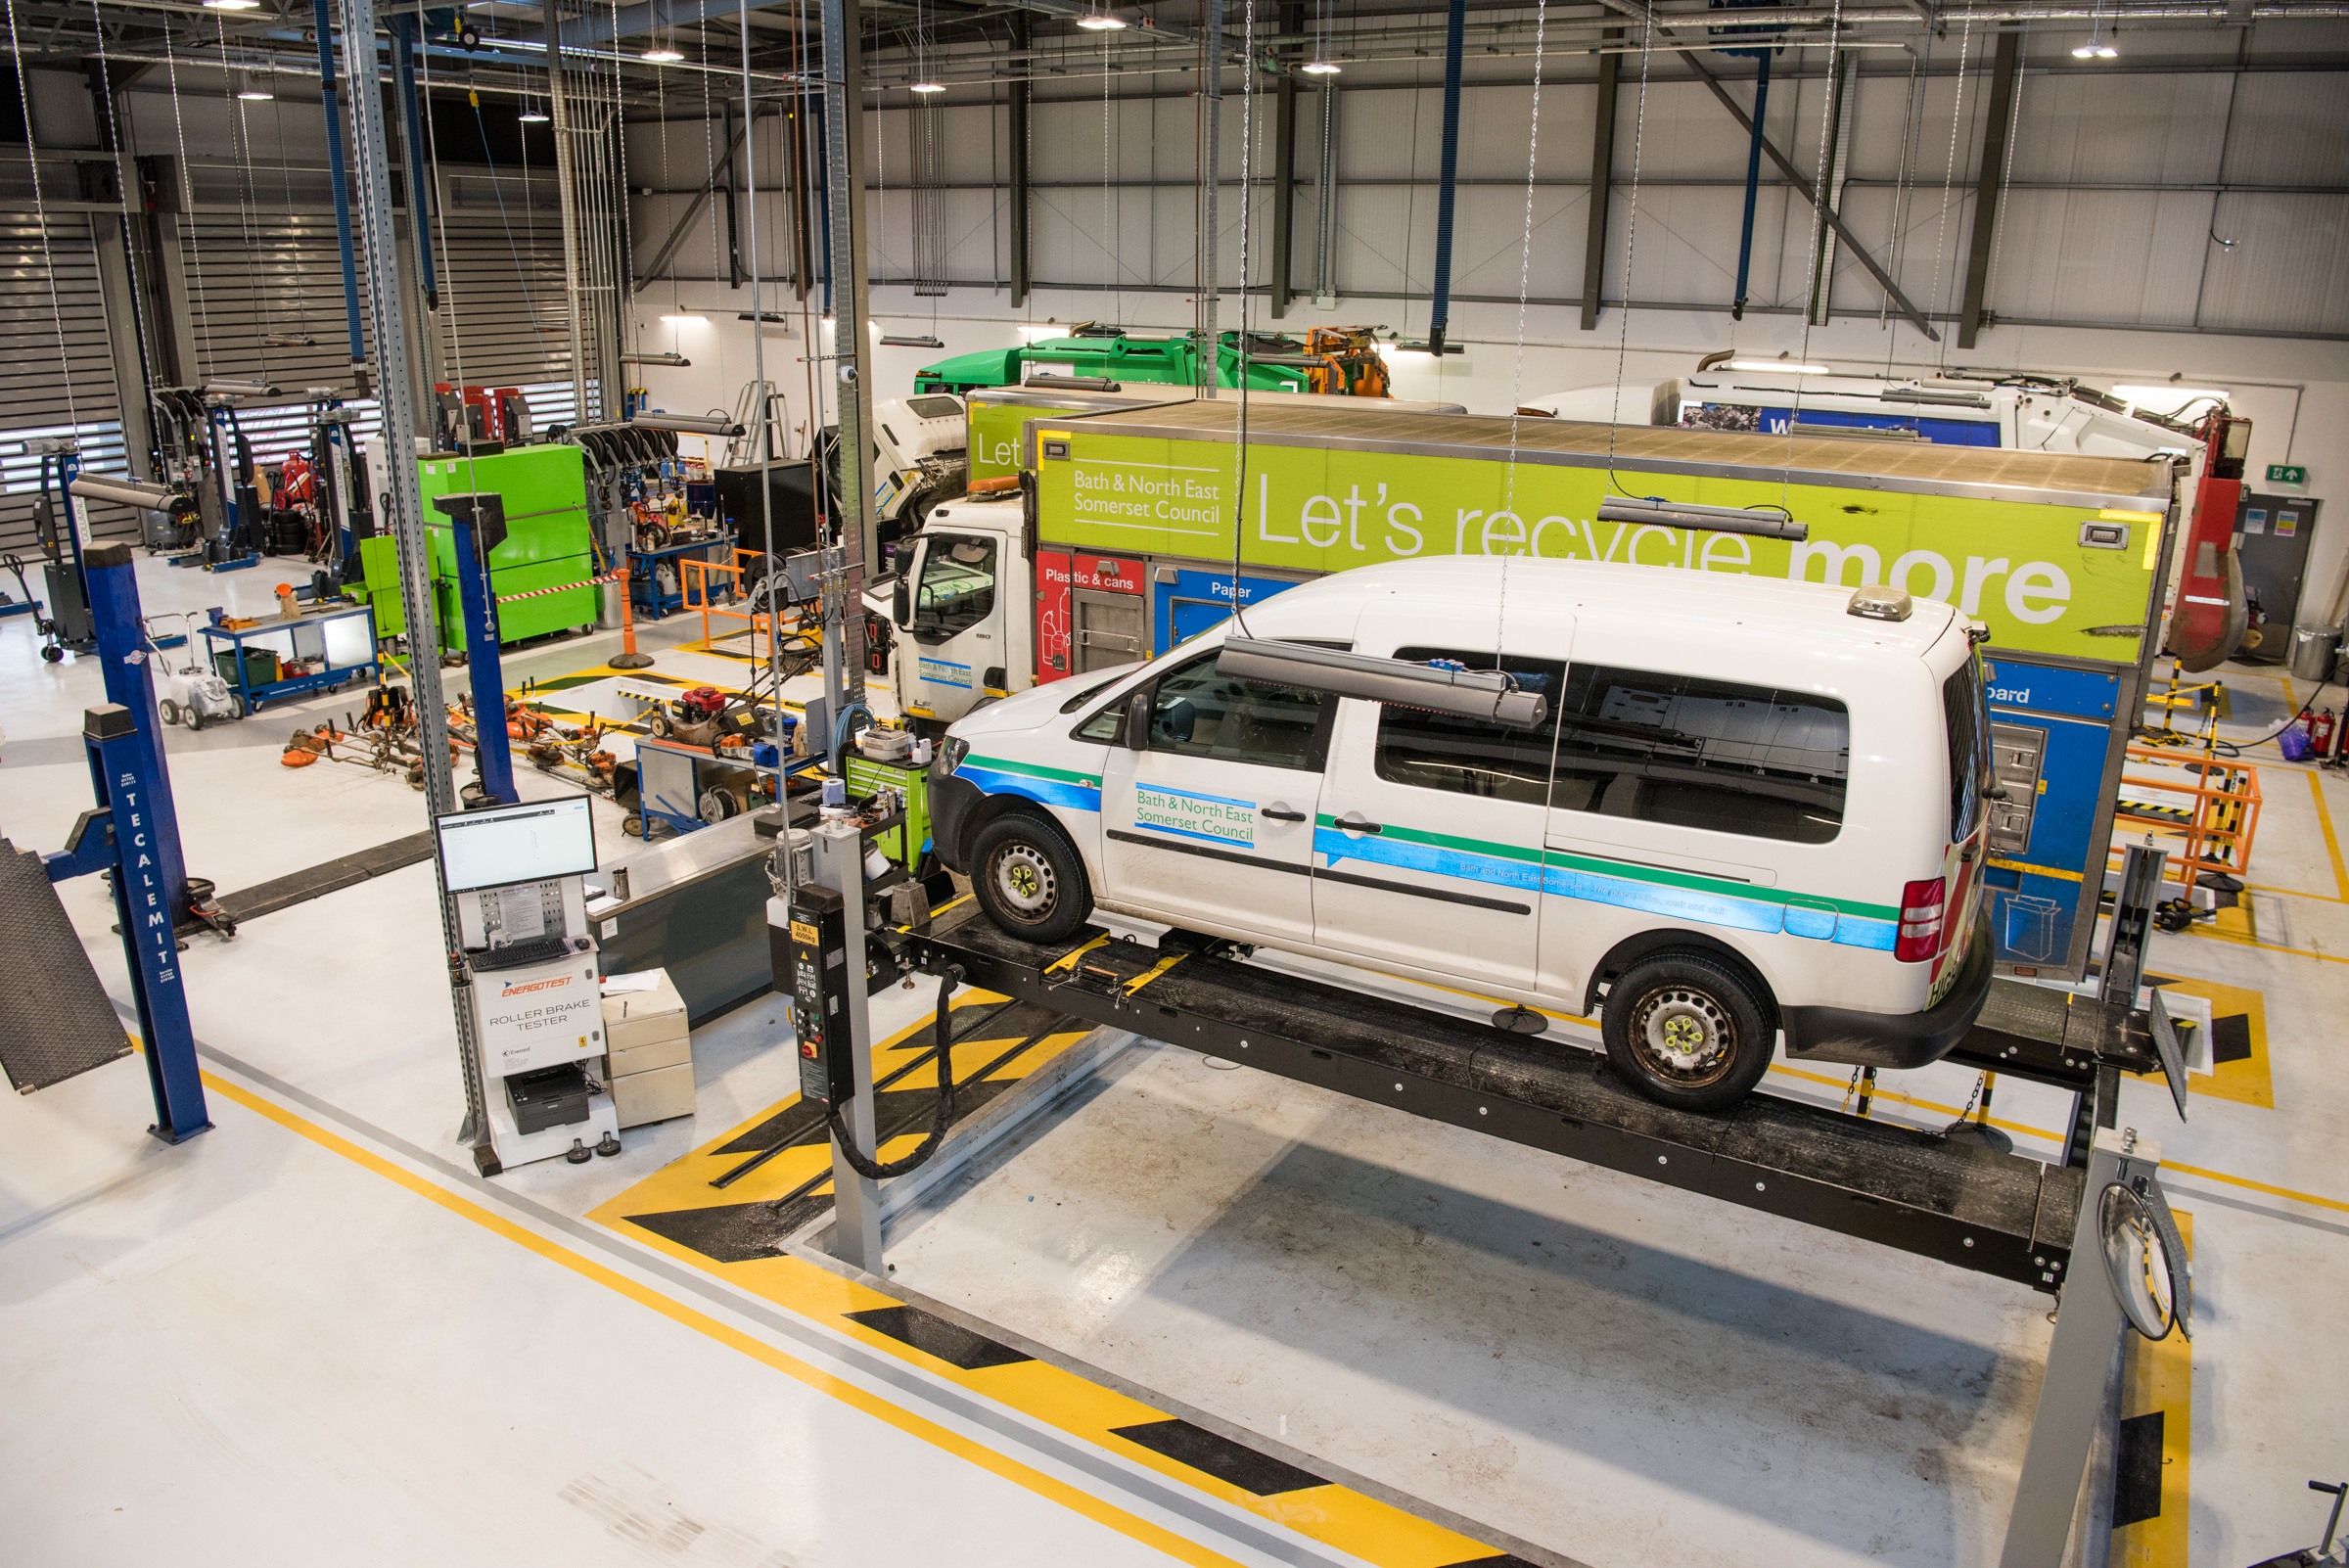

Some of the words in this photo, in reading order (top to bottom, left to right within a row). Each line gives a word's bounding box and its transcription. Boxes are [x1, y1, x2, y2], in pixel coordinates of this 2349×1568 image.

[1771, 418, 1787, 434] W
[980, 433, 1021, 467] Let
[334, 452, 345, 498] COLUMNLIFT
[1075, 470, 1109, 490] Bath
[1113, 474, 1125, 491] &
[1129, 475, 1180, 497] North
[1185, 479, 1220, 500] East
[73, 495, 90, 542] COLUMNLIF
[1075, 492, 1150, 518] Somerset
[1156, 500, 1220, 524] Council
[1259, 473, 1424, 557] Let's
[1787, 539, 2071, 624] more
[1046, 569, 1089, 584] Plastic
[1092, 574, 1101, 585] &
[1104, 576, 1134, 589] cans
[1212, 581, 1252, 598] Paper
[919, 661, 932, 669] Bath
[939, 665, 958, 675] Noth
[919, 669, 947, 681] Somerset
[948, 675, 973, 685] Council
[1987, 687, 2030, 704] oard
[1137, 791, 1166, 807] Bath
[1169, 797, 1177, 810] &
[1181, 799, 1222, 818] North
[1225, 807, 1253, 824] East
[1137, 807, 1198, 831] Somerset
[1202, 819, 1253, 841] Council
[126, 792, 168, 965] TECALEMIT
[1459, 862, 1479, 873] Bath
[1480, 867, 1496, 876] and
[1497, 869, 1520, 880] North
[1522, 874, 1542, 883] East
[1543, 877, 1583, 891] Somerset
[1593, 885, 1608, 896] The
[1610, 889, 1634, 899] place
[1635, 893, 1644, 901] to
[1665, 899, 1685, 908] work
[1688, 901, 1706, 912] and
[1707, 905, 1726, 916] visit
[795, 931, 816, 944] 4000kg
[502, 976, 573, 997] ENERGOTEST
[489, 1009, 543, 1026] ROLLER
[545, 999, 590, 1015] BRAKE
[517, 1015, 568, 1031] TESTER
